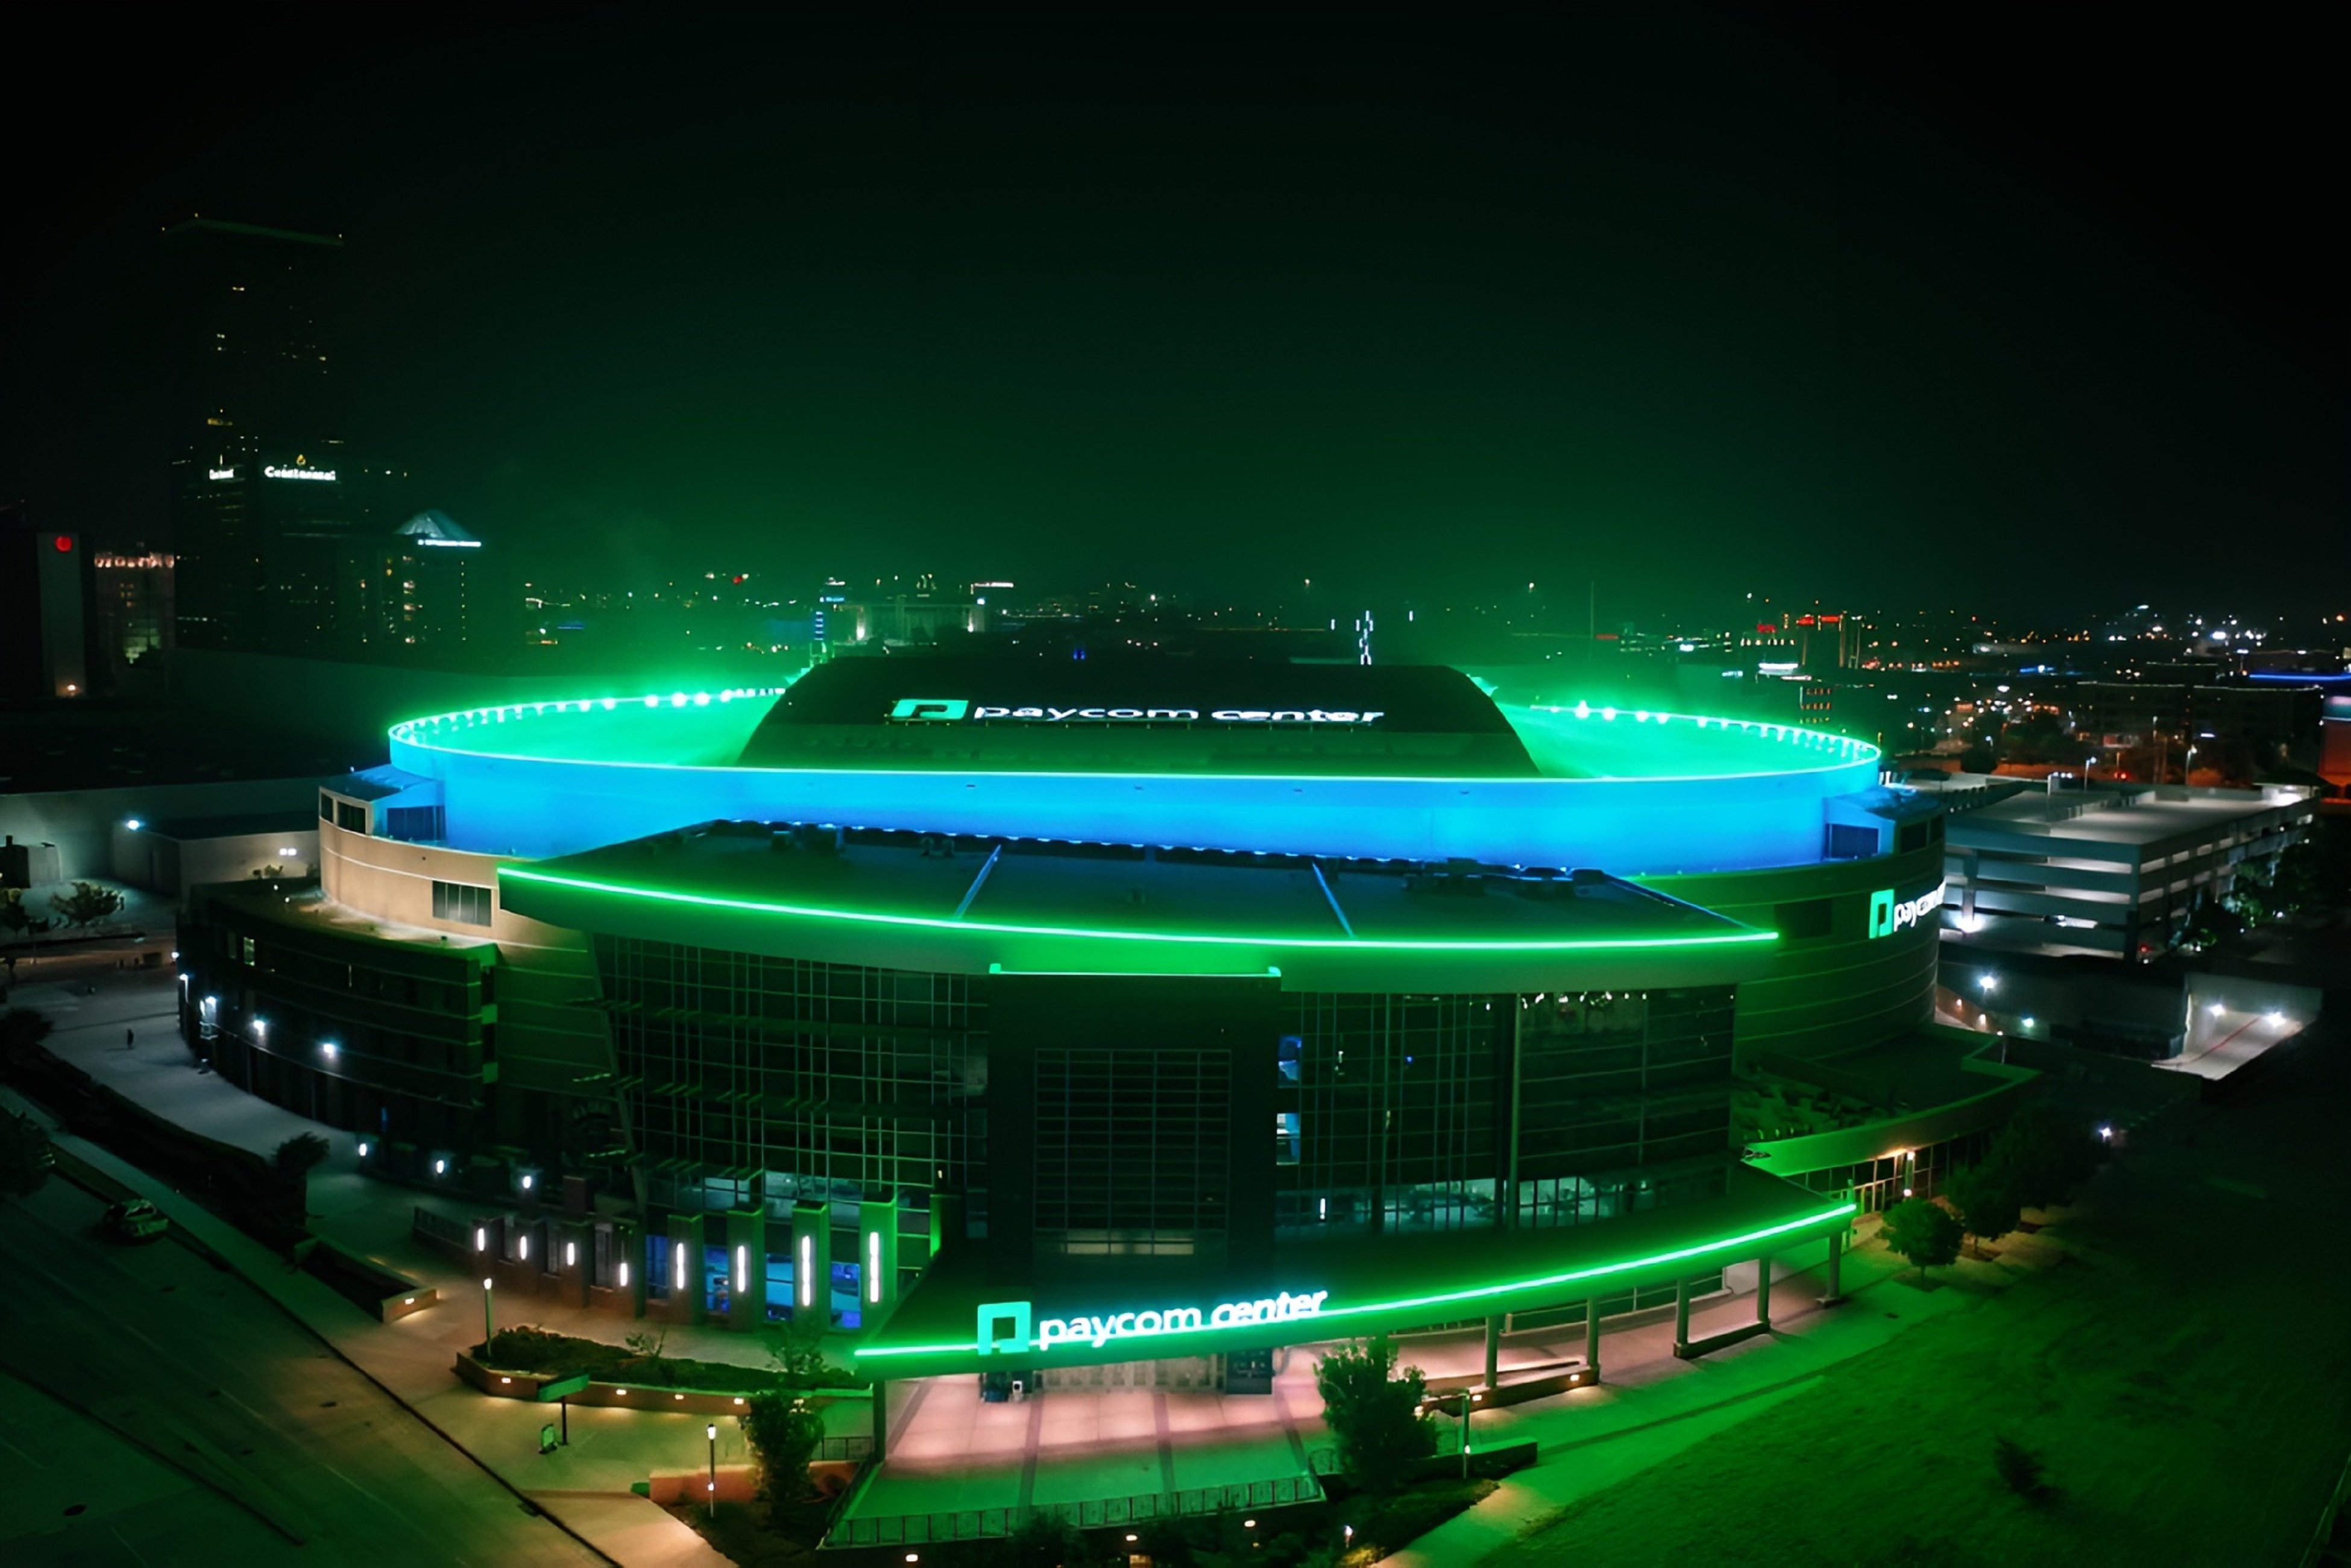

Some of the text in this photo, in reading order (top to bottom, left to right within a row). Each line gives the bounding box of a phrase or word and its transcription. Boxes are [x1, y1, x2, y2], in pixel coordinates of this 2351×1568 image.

[974, 707, 1385, 722] paycom center
[1039, 1290, 1327, 1350] paycom center
